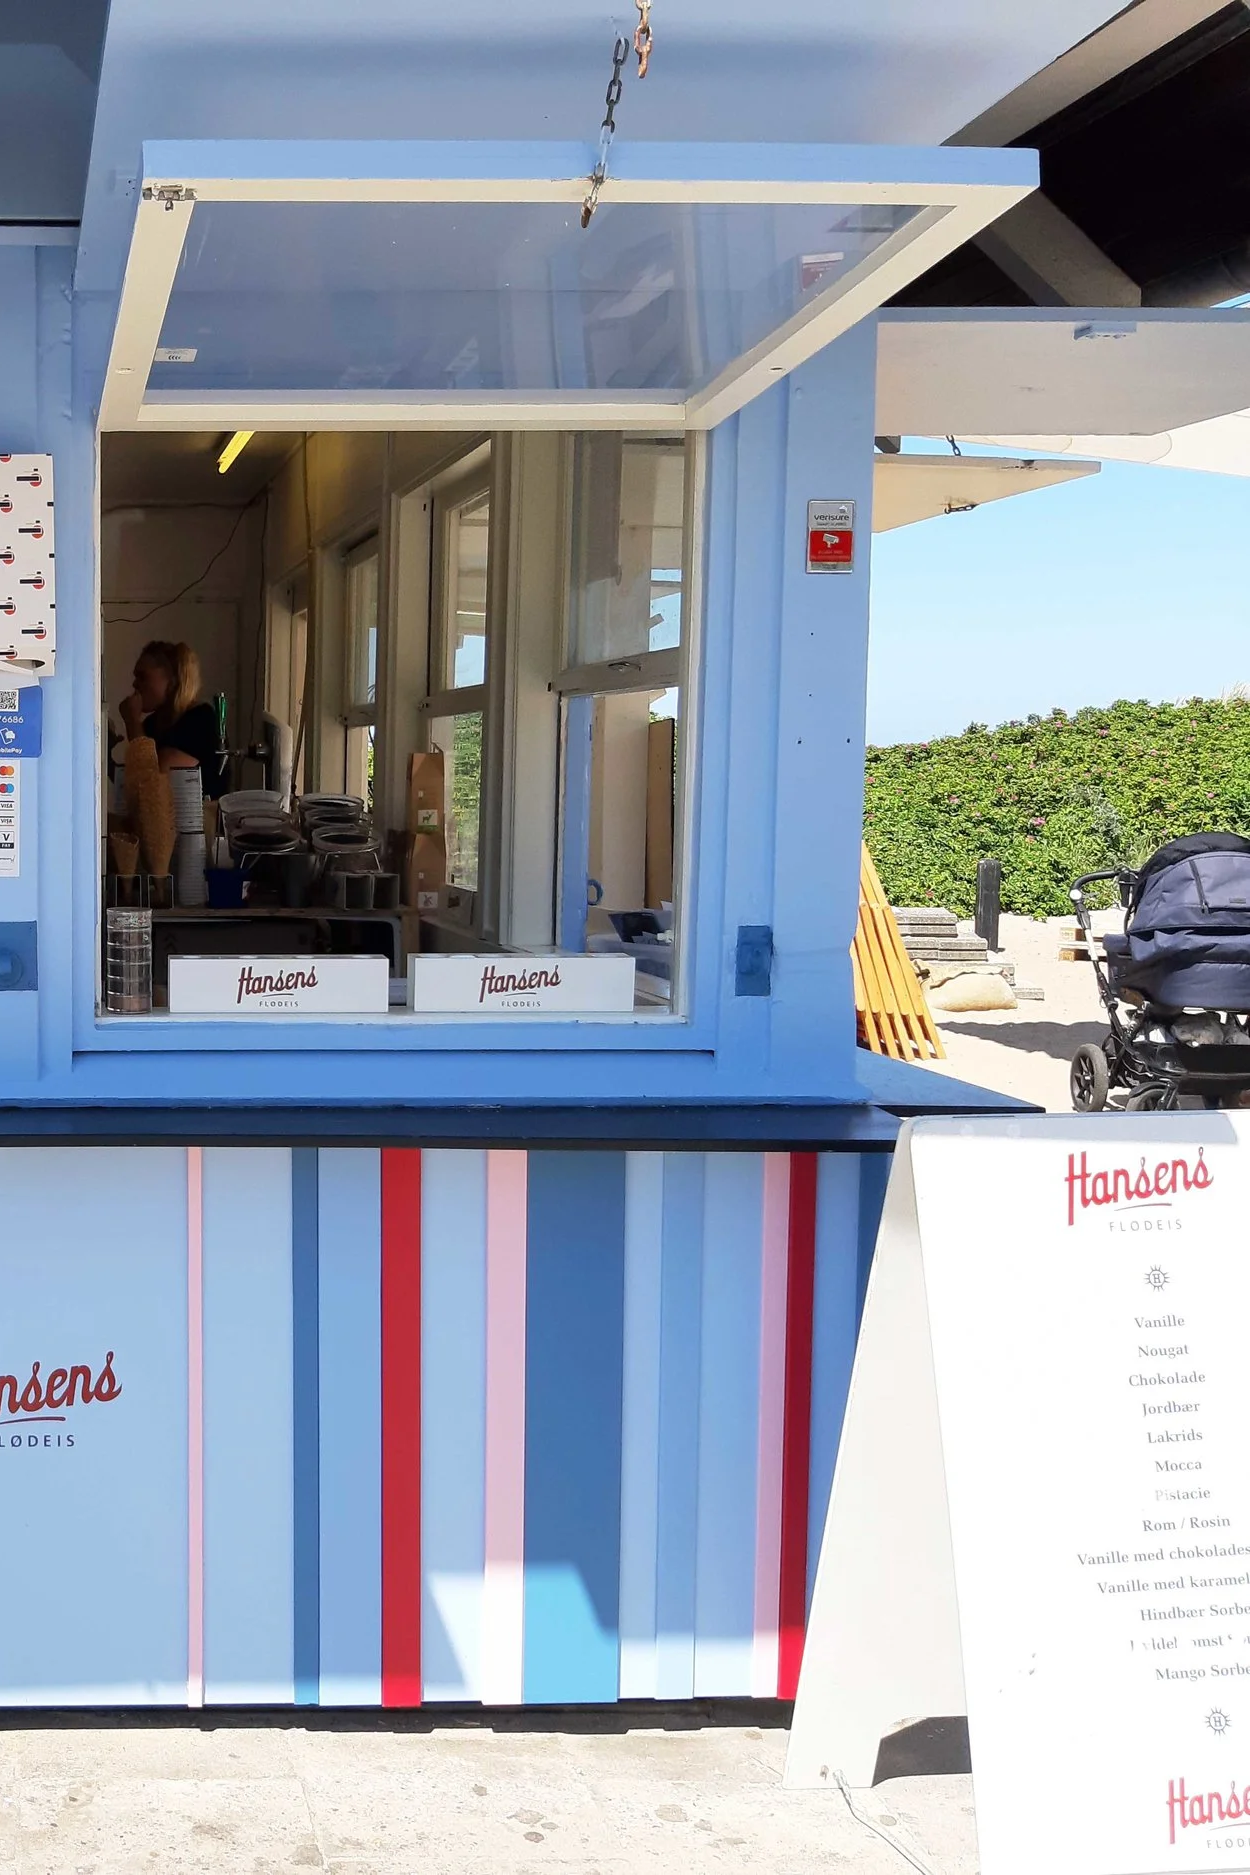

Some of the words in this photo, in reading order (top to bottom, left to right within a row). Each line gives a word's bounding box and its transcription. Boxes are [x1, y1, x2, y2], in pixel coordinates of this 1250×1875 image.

[2, 833, 10, 841] V
[237, 965, 319, 1004] Hansens
[479, 964, 562, 1003] Hansens
[1064, 1146, 1214, 1226] Hansens
[1134, 1314, 1185, 1329] Vanille
[1138, 1344, 1189, 1359] Nougat
[1128, 1370, 1206, 1387] Chokolade
[1141, 1401, 1201, 1417] Jordbær
[1147, 1428, 1203, 1444] Lakrids
[1154, 1459, 1203, 1472] Mocca
[1155, 1486, 1211, 1501] Pistacie
[1142, 1518, 1177, 1532] Rom
[1189, 1514, 1231, 1530] Rosin
[1077, 1550, 1130, 1566] Vanille
[1133, 1548, 1165, 1563] med
[1097, 1579, 1150, 1595] Vanille
[1154, 1576, 1186, 1591] med
[1190, 1571, 1250, 1588] karamel
[1140, 1605, 1206, 1621] Hindbær
[1155, 1668, 1206, 1682] Mango
